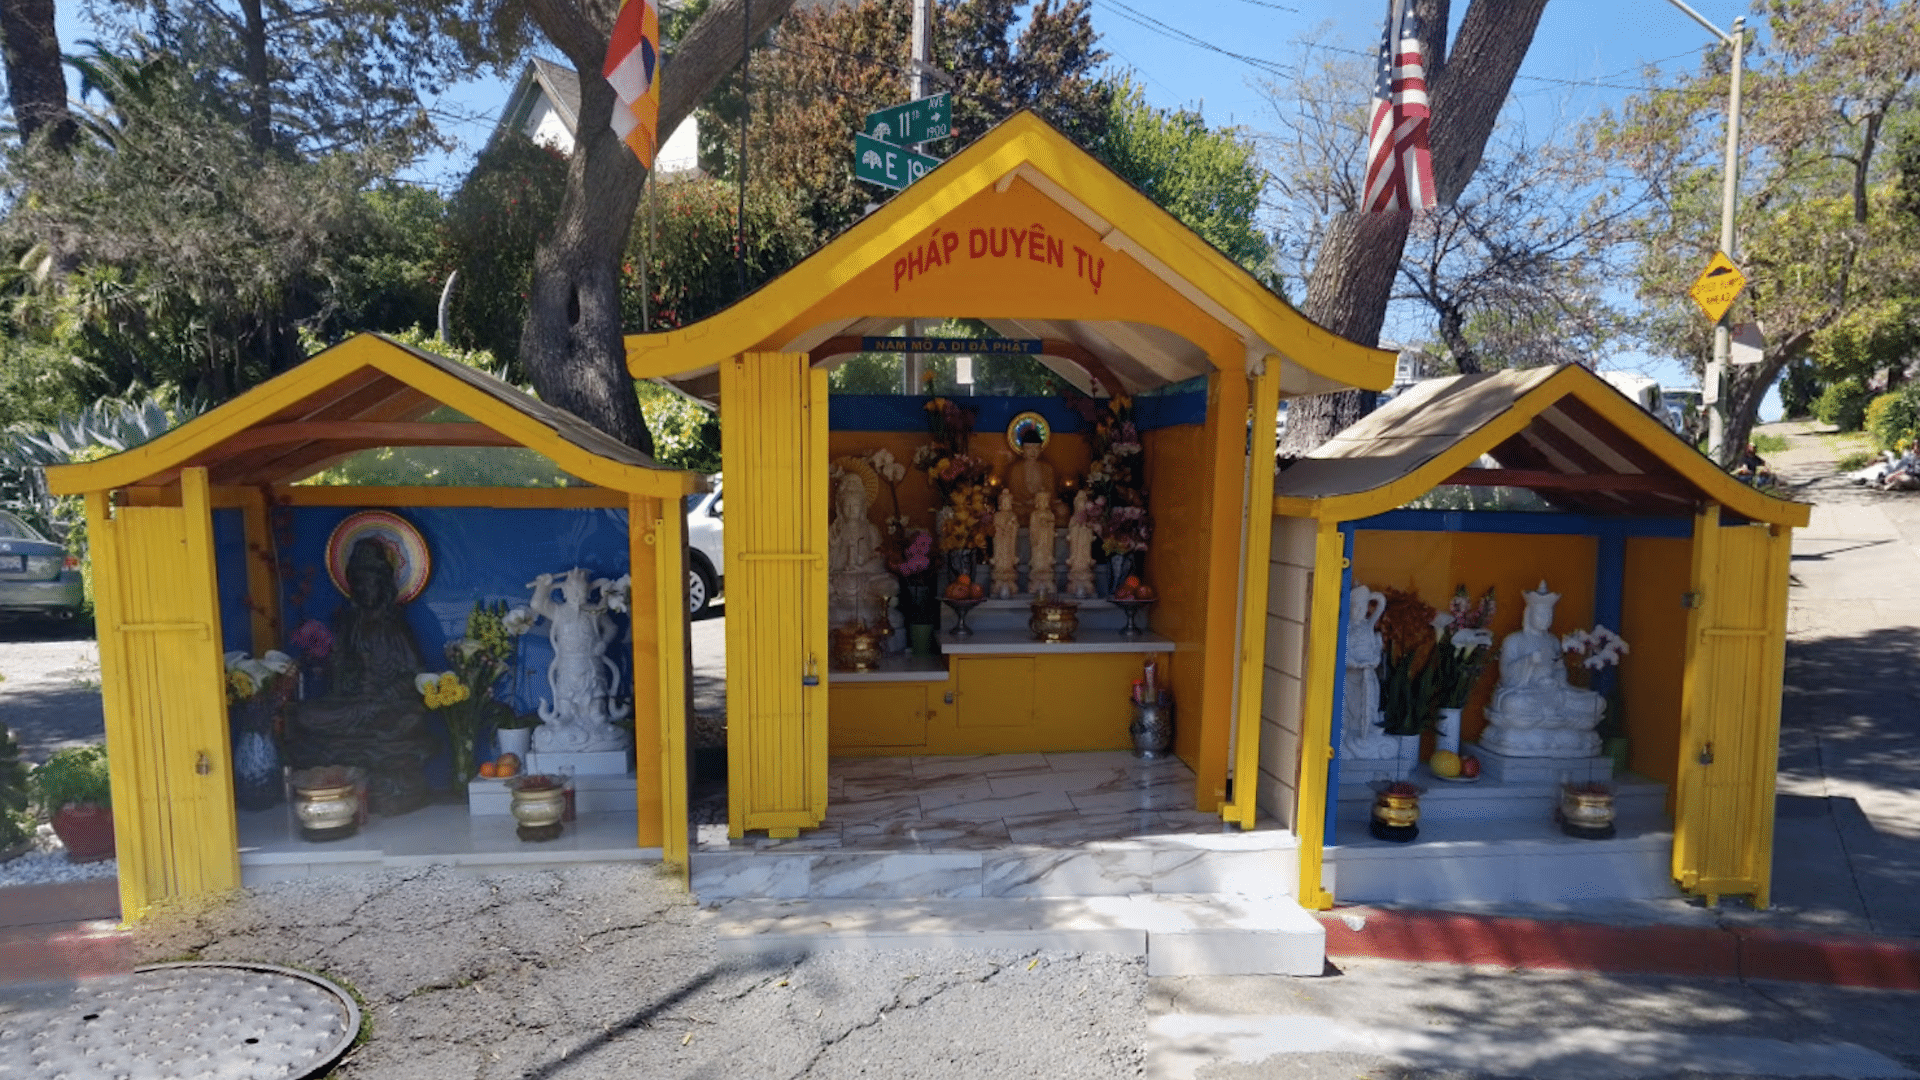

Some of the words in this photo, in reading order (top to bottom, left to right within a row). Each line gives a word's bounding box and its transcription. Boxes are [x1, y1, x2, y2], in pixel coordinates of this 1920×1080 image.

[928, 96, 945, 110] AVE
[926, 123, 947, 139] 1900
[885, 151, 898, 180] E
[893, 227, 959, 293] PHÁP
[968, 222, 1064, 268] DUYÊN
[874, 340, 906, 351] NAM
[937, 340, 947, 351] A
[951, 340, 965, 351] DI
